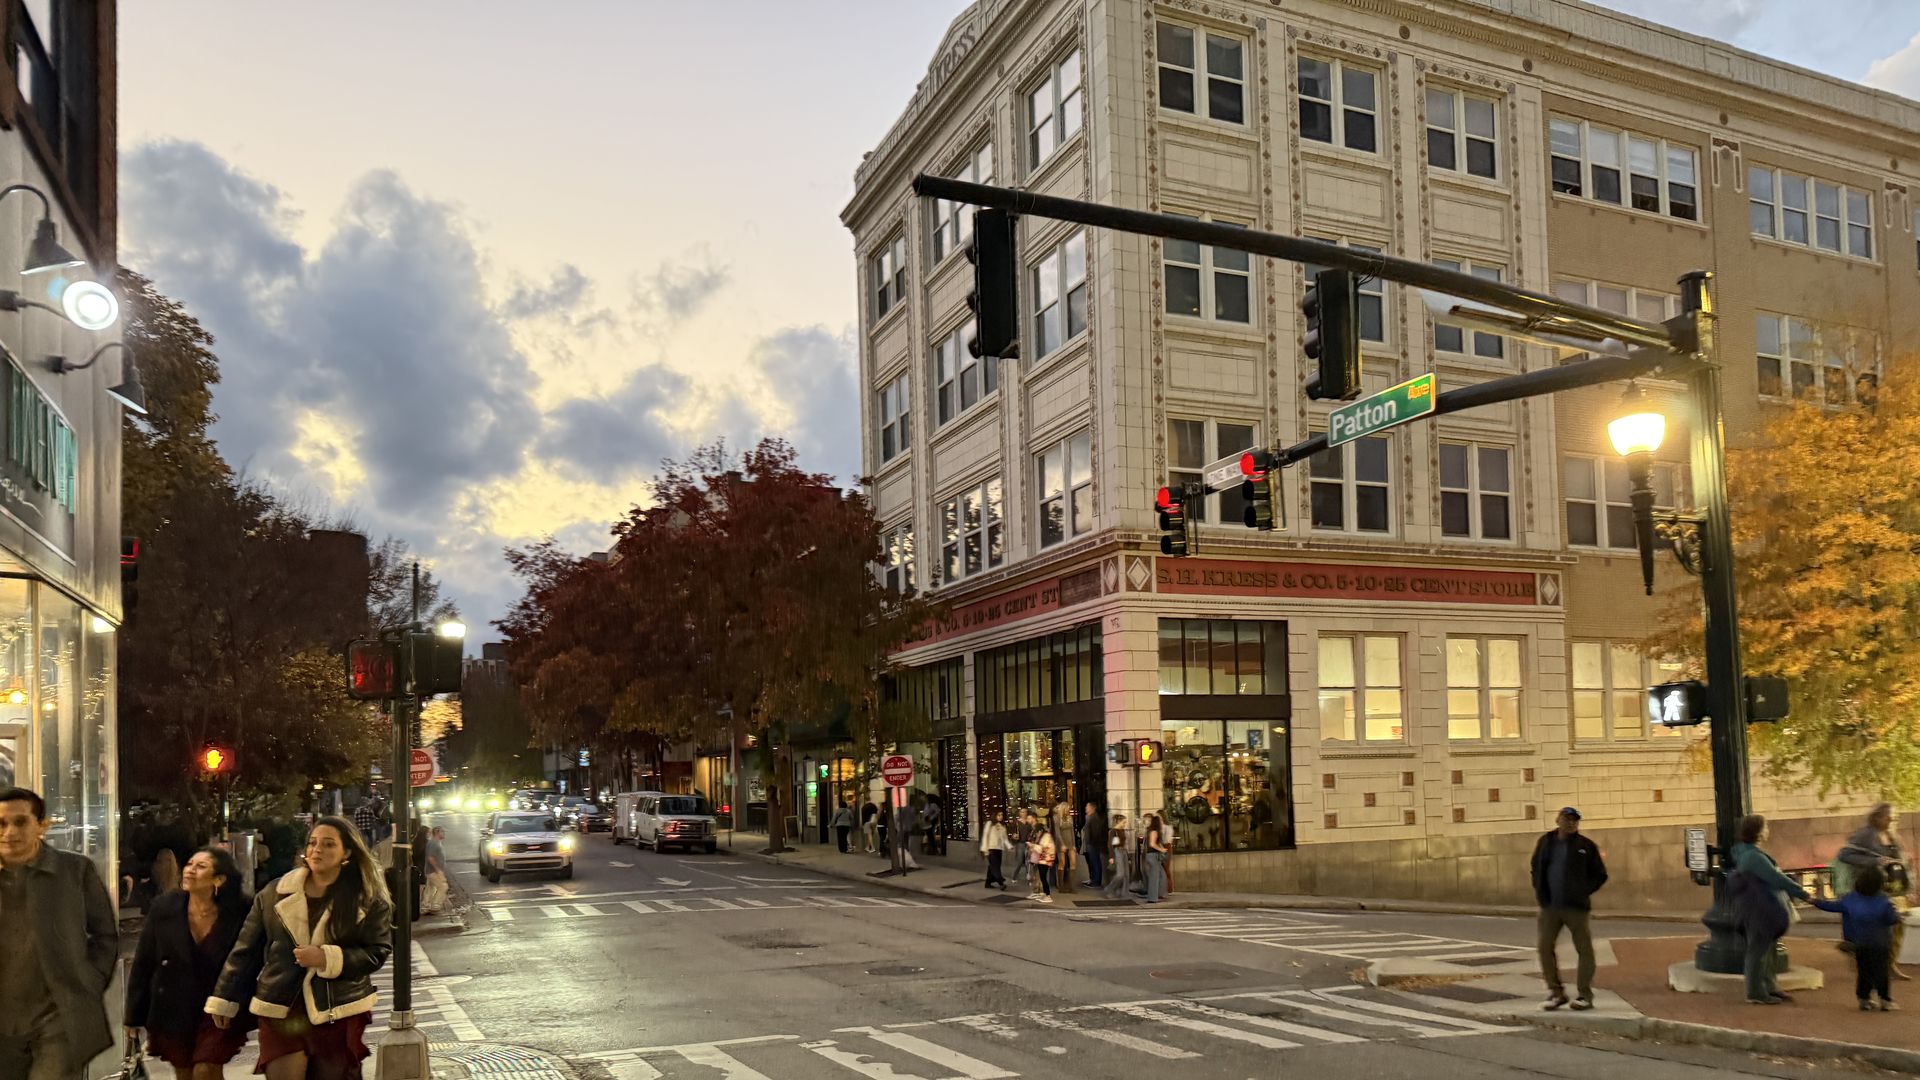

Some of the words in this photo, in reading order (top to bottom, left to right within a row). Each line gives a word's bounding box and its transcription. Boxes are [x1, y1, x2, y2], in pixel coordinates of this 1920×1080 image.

[936, 22, 976, 88] KRESS
[1332, 400, 1397, 441] Patton
[1202, 569, 1278, 588] KRESS
[1282, 572, 1297, 588] &
[1301, 573, 1333, 590] CO.
[1410, 578, 1466, 595] CENT
[1469, 580, 1535, 597] STORE
[1005, 595, 1037, 615] CENT
[414, 755, 427, 763] NOT
